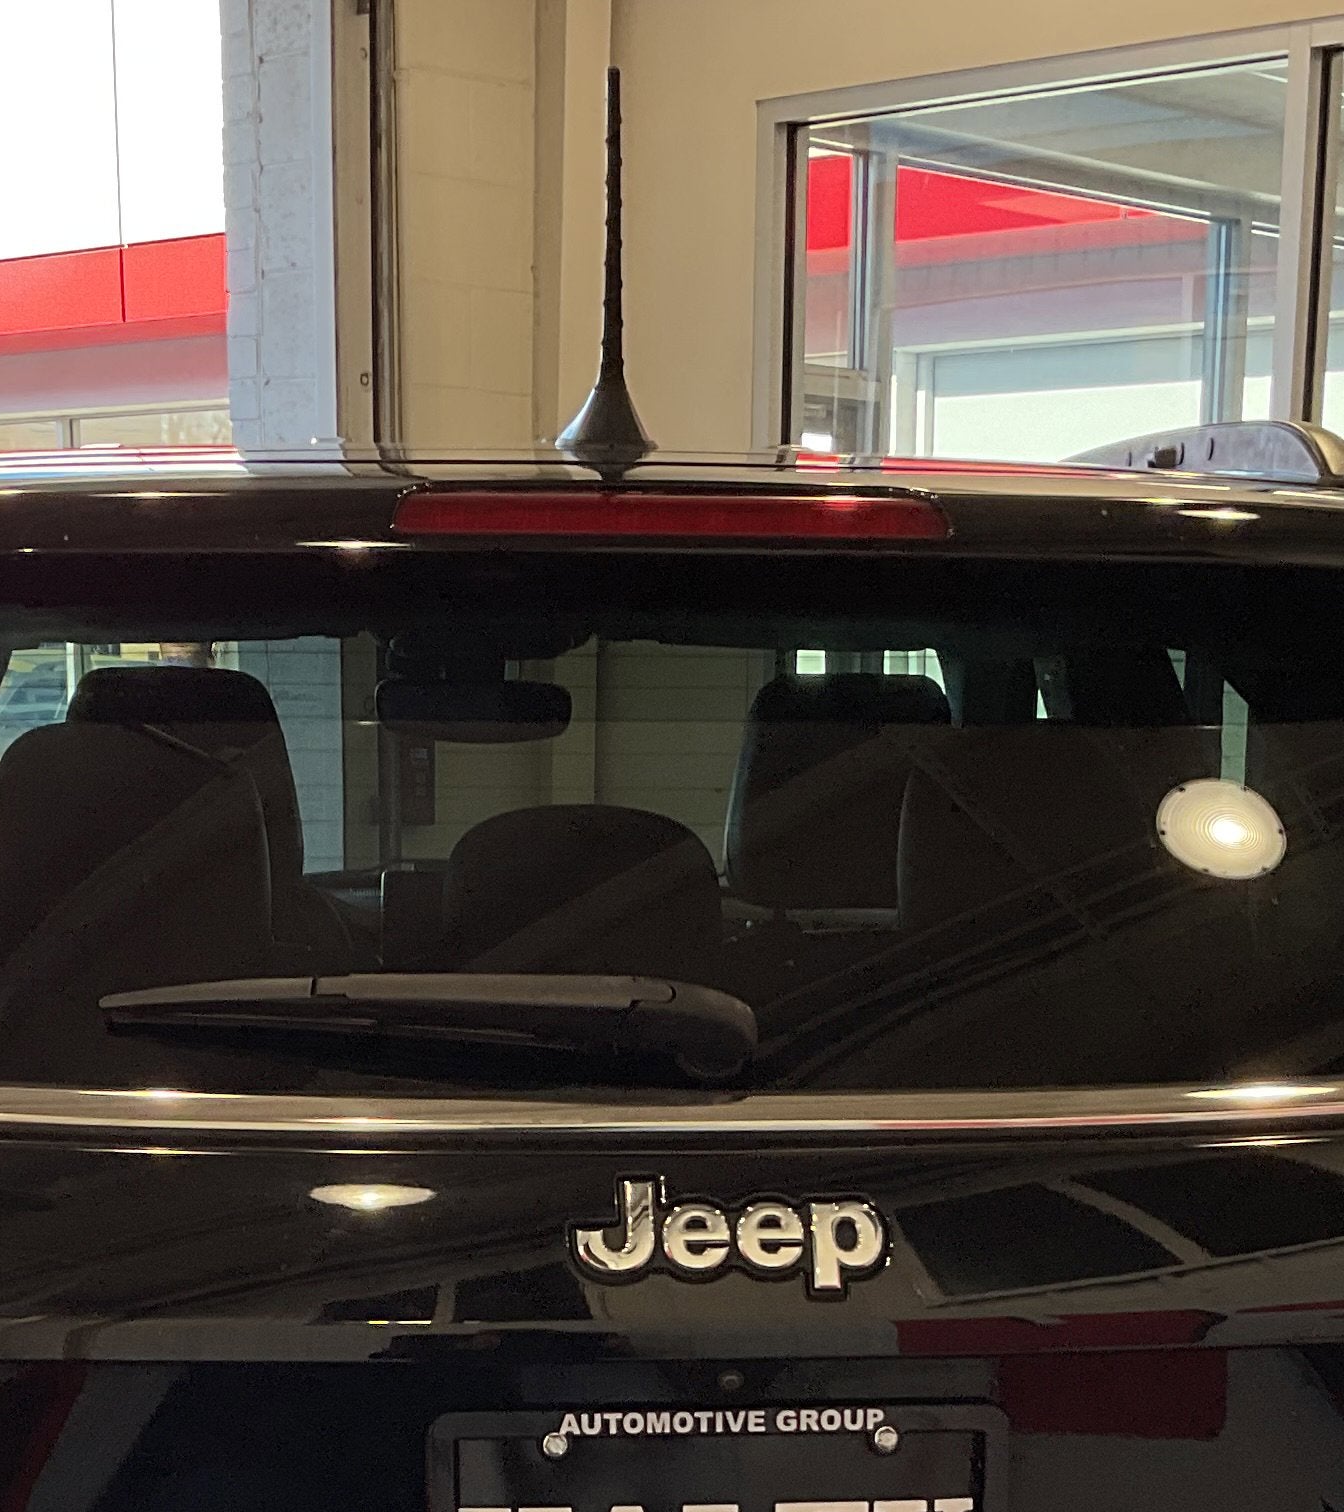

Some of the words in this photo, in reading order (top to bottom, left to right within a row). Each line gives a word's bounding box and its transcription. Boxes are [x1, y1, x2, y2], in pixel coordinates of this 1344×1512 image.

[574, 1179, 886, 1291] Jeep
[558, 1410, 766, 1437] AUTOMOTIVE
[775, 1408, 886, 1433] GROUP
